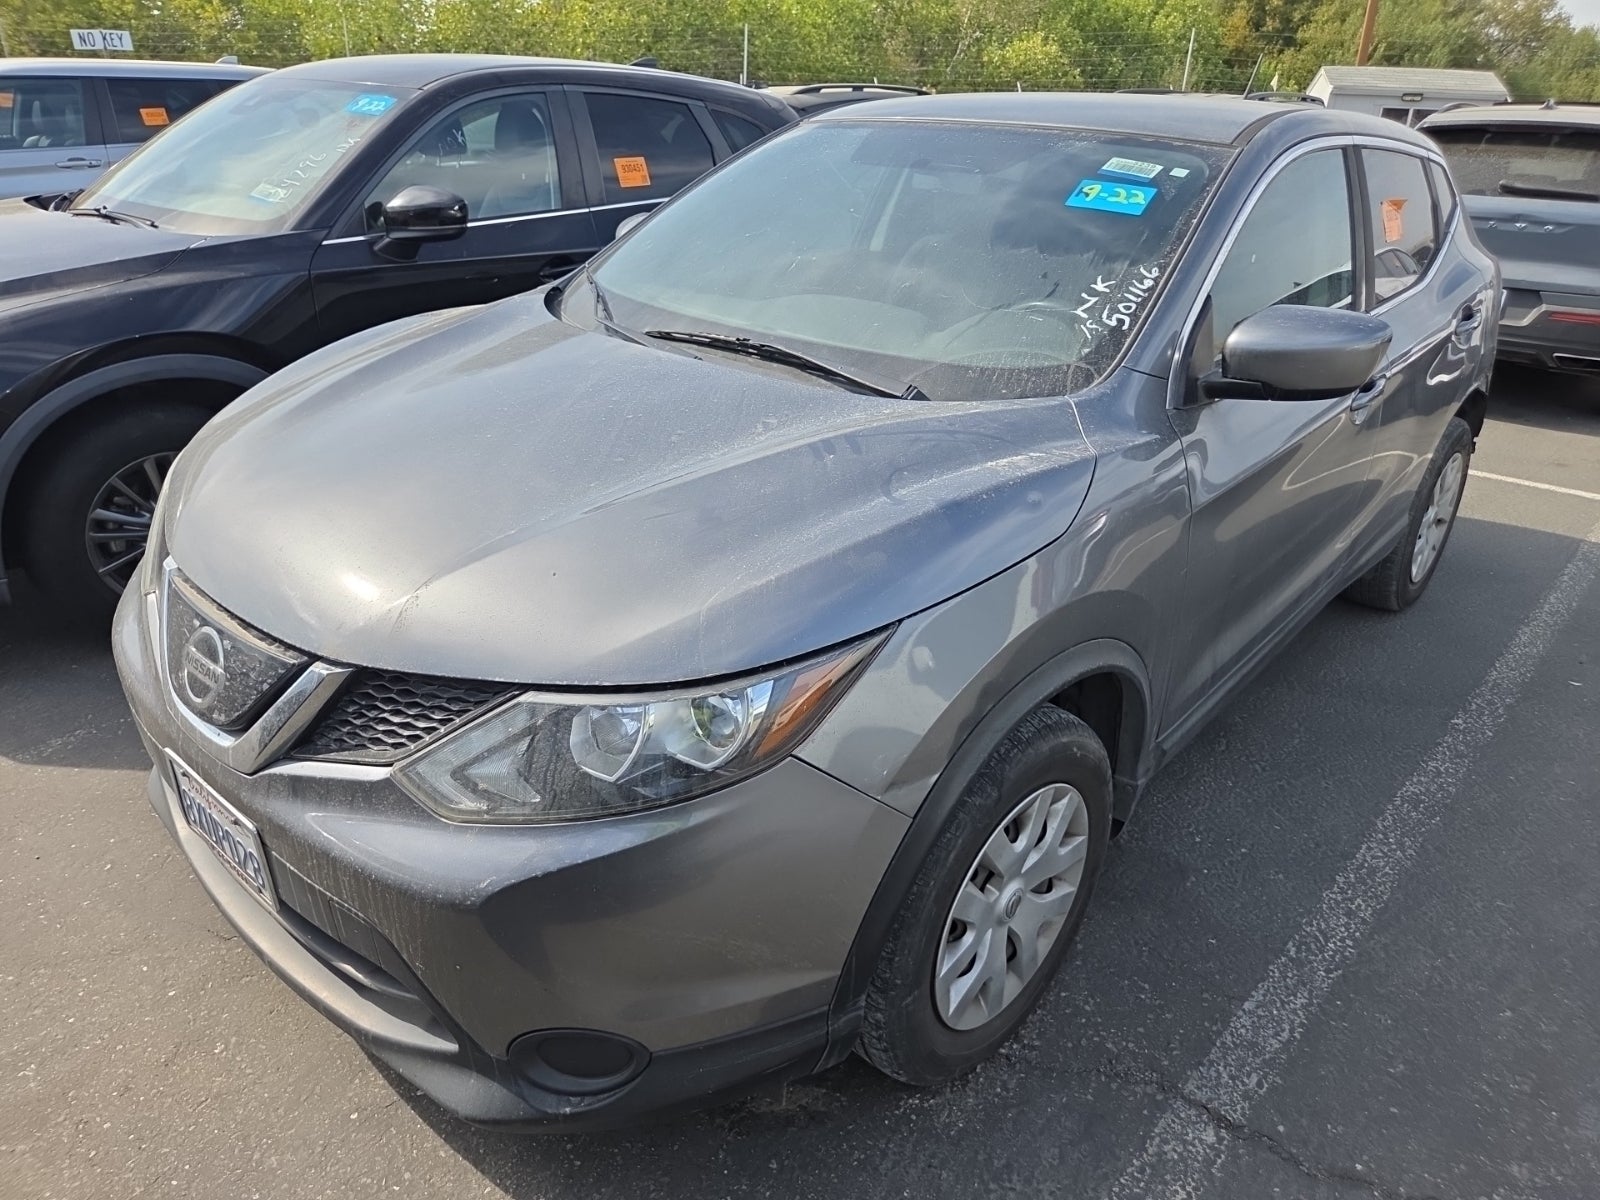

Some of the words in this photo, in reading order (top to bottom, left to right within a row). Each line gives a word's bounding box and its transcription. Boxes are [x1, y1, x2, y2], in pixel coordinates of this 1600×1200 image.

[78, 32, 96, 48] NO
[101, 31, 124, 49] KEY
[1080, 184, 1147, 205] 9-22
[1070, 275, 1117, 319] NK
[1102, 264, 1161, 331] 501166
[184, 653, 220, 685] NISSAN
